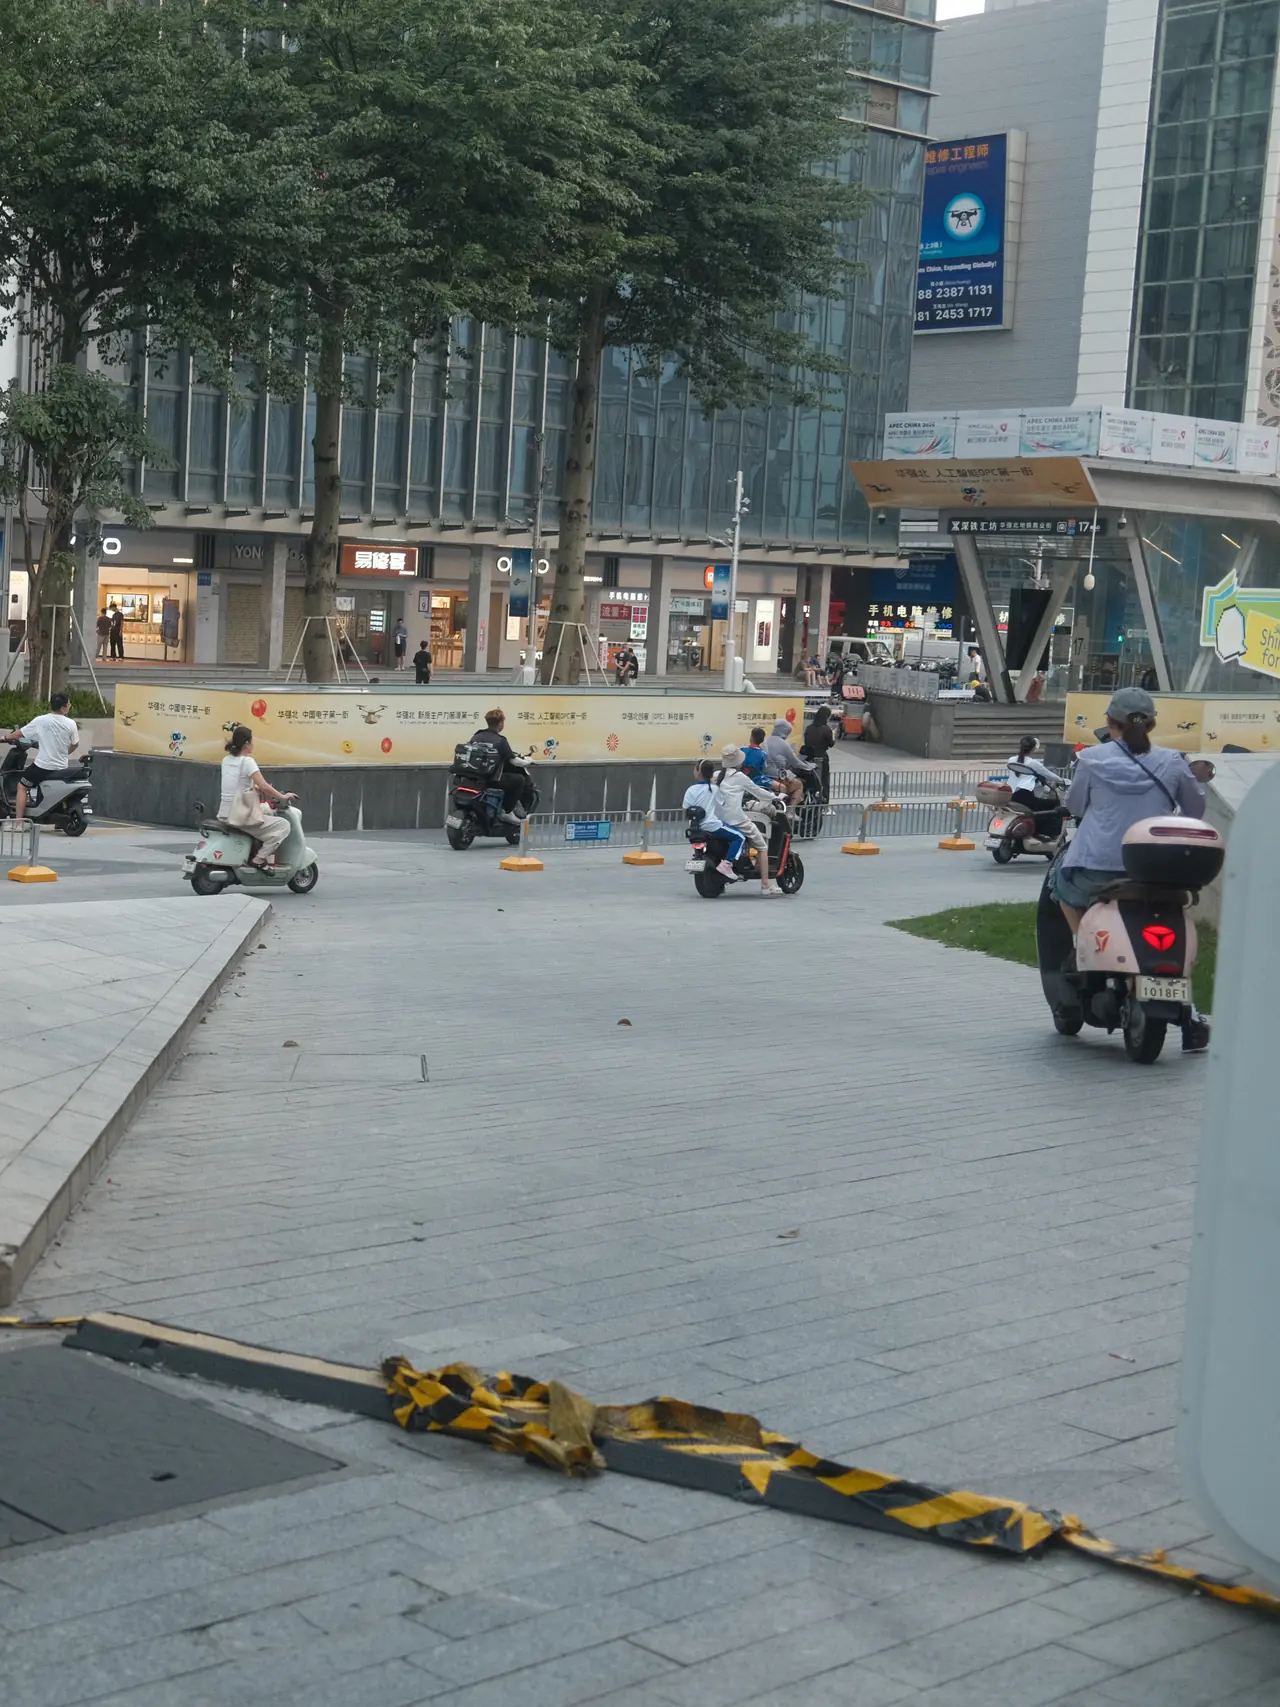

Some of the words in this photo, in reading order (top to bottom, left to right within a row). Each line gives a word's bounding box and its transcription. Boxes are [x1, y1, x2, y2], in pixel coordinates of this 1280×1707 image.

[936, 286, 965, 298] 2387
[968, 284, 993, 296] 1131
[935, 308, 964, 320] 2453
[968, 306, 993, 318] 1717
[961, 520, 998, 532] 深铁汇坊
[1078, 521, 1090, 532] 17
[354, 551, 407, 571] 易修哥
[1073, 637, 1085, 656] 17
[147, 701, 166, 712] 华强北
[168, 703, 211, 715] 中国电子第一街
[277, 709, 299, 719] 华强北
[302, 709, 349, 720] 中国电子第一街
[396, 710, 415, 720] 华强北
[517, 711, 535, 720] 华强北
[1142, 985, 1187, 1000] 1018F1
